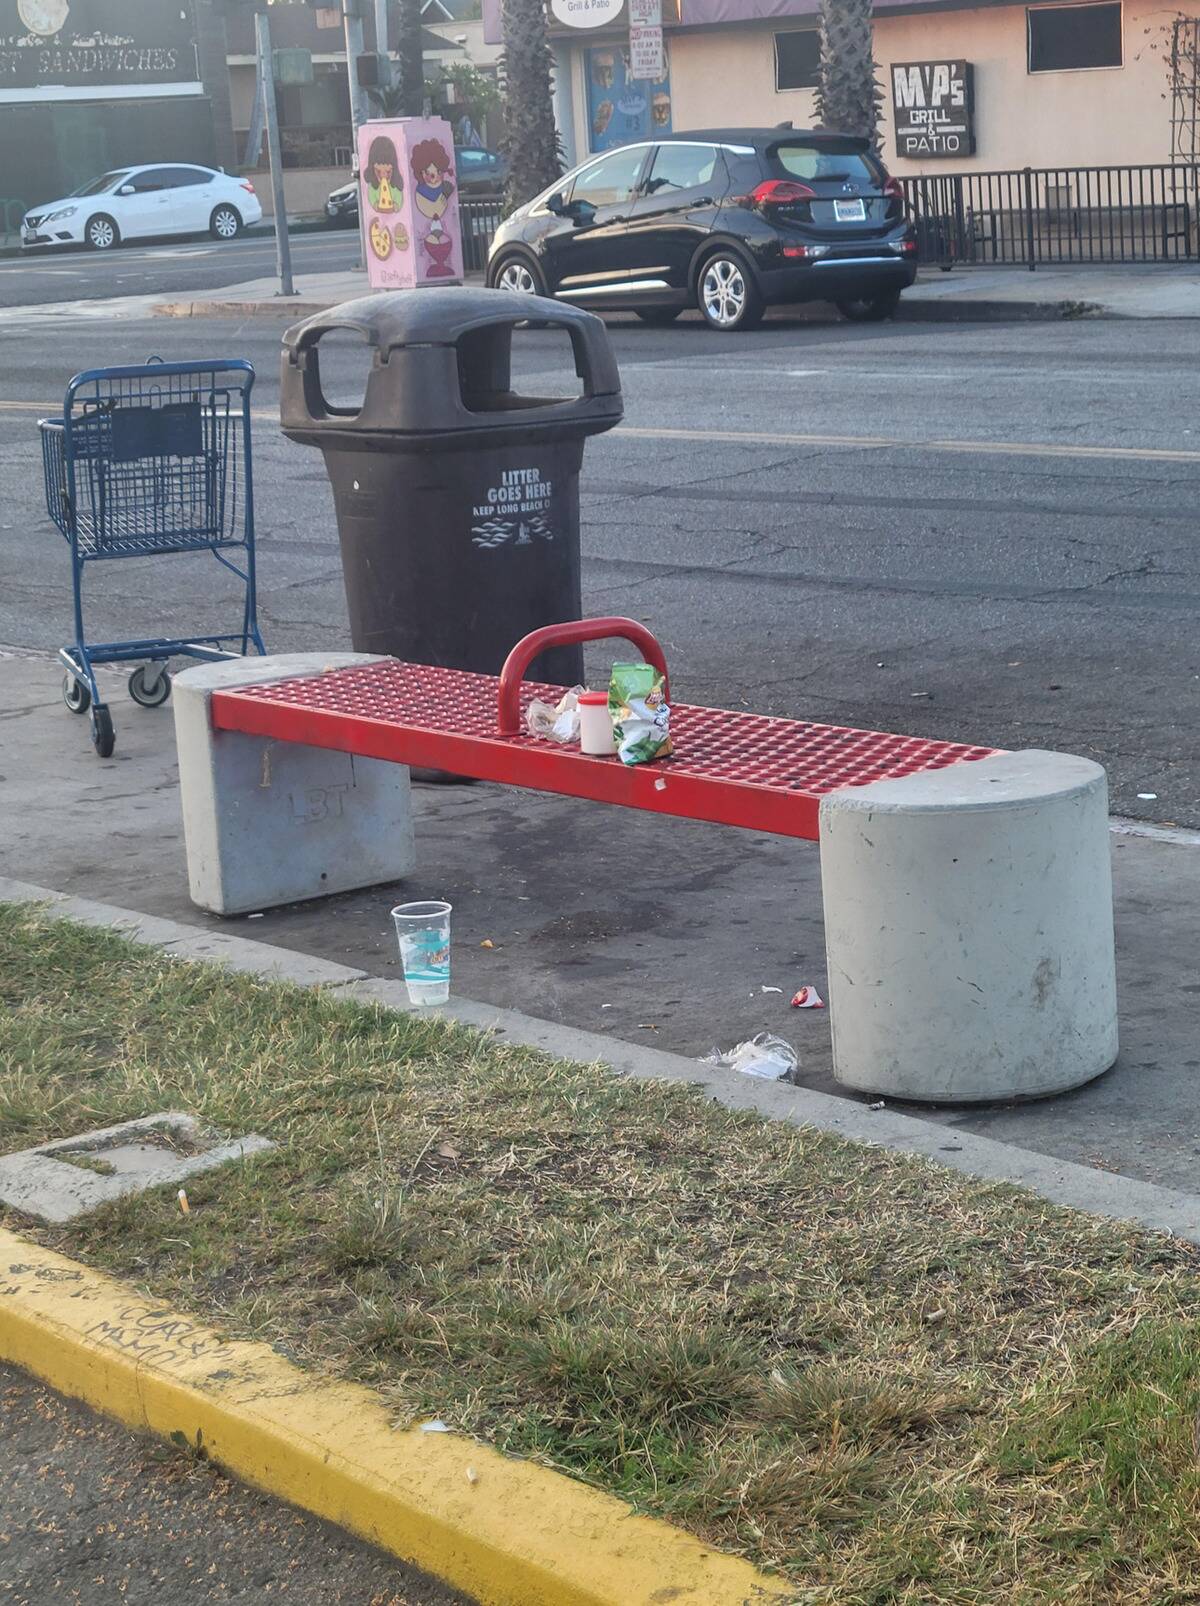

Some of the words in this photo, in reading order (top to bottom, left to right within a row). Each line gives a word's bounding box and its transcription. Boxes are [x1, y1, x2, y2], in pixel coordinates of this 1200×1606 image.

[568, 1, 583, 11] Grill
[584, 0, 590, 10] &
[591, 0, 609, 9] Patio
[39, 48, 177, 72] SANDWICHES
[909, 109, 951, 124] GRILL
[927, 122, 936, 136] &
[906, 136, 960, 152] PATIO
[502, 468, 540, 486] LITTER
[487, 486, 522, 503] GOES
[525, 481, 552, 499] HERE
[497, 503, 519, 514] LONG
[520, 500, 543, 512] BEACH
